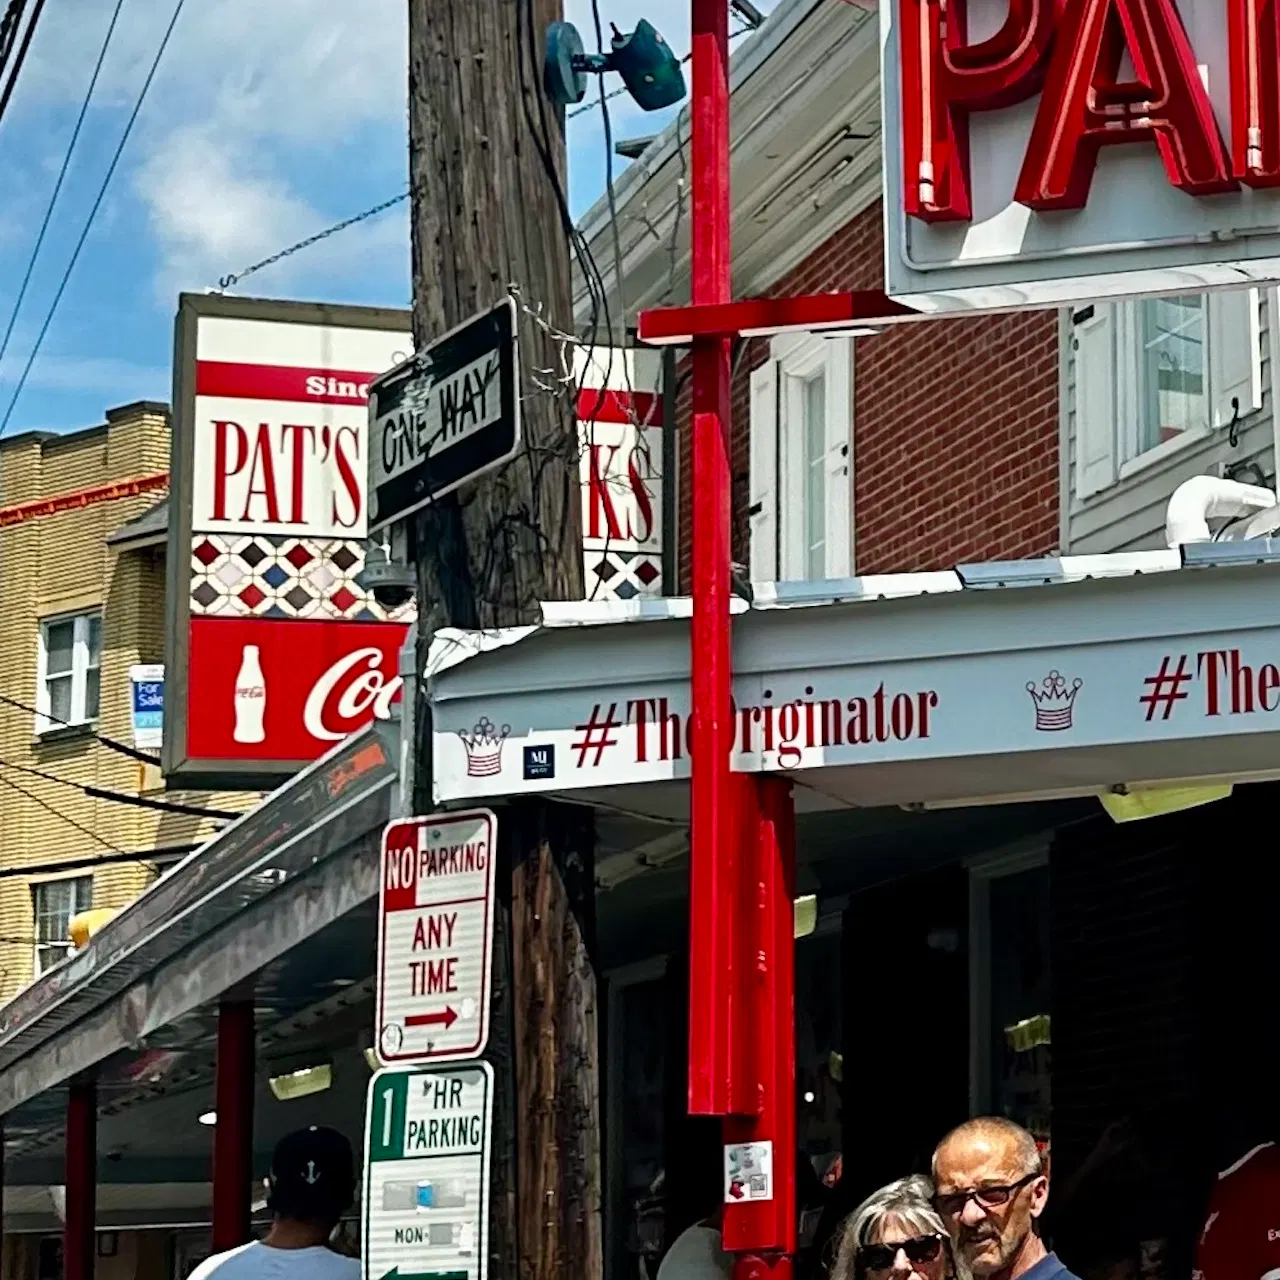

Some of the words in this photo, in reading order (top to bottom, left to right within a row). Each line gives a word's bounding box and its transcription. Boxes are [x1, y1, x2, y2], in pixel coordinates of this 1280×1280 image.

[382, 400, 429, 474] ONE
[440, 359, 494, 441] WAY
[209, 420, 361, 529] PAT'S
[571, 681, 938, 769] #Thriginator
[386, 846, 415, 890] NO
[419, 841, 485, 878] PARKING
[412, 912, 458, 952] ANY
[408, 957, 459, 997] TIME
[381, 1087, 394, 1147] 1
[434, 1078, 463, 1110] HR
[407, 1115, 481, 1150] PARKING
